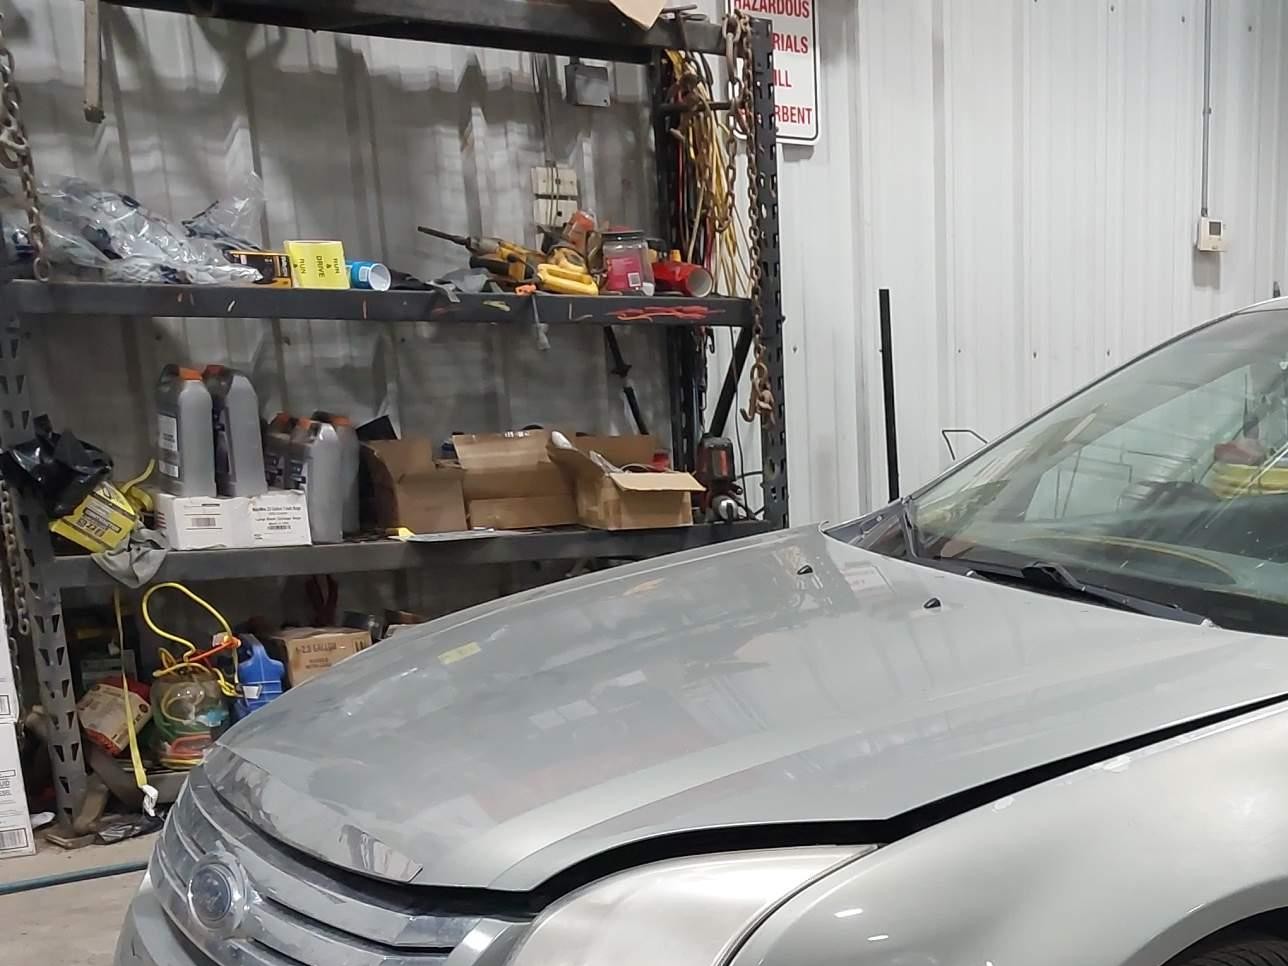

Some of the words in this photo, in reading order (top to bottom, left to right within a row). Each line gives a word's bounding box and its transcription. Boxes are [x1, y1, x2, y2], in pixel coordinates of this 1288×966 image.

[734, 0, 809, 18] HAZARDOUS
[772, 33, 809, 54] RIALS
[773, 69, 792, 88] ILL
[774, 105, 813, 125] RBENT
[316, 255, 325, 278] DRIVE
